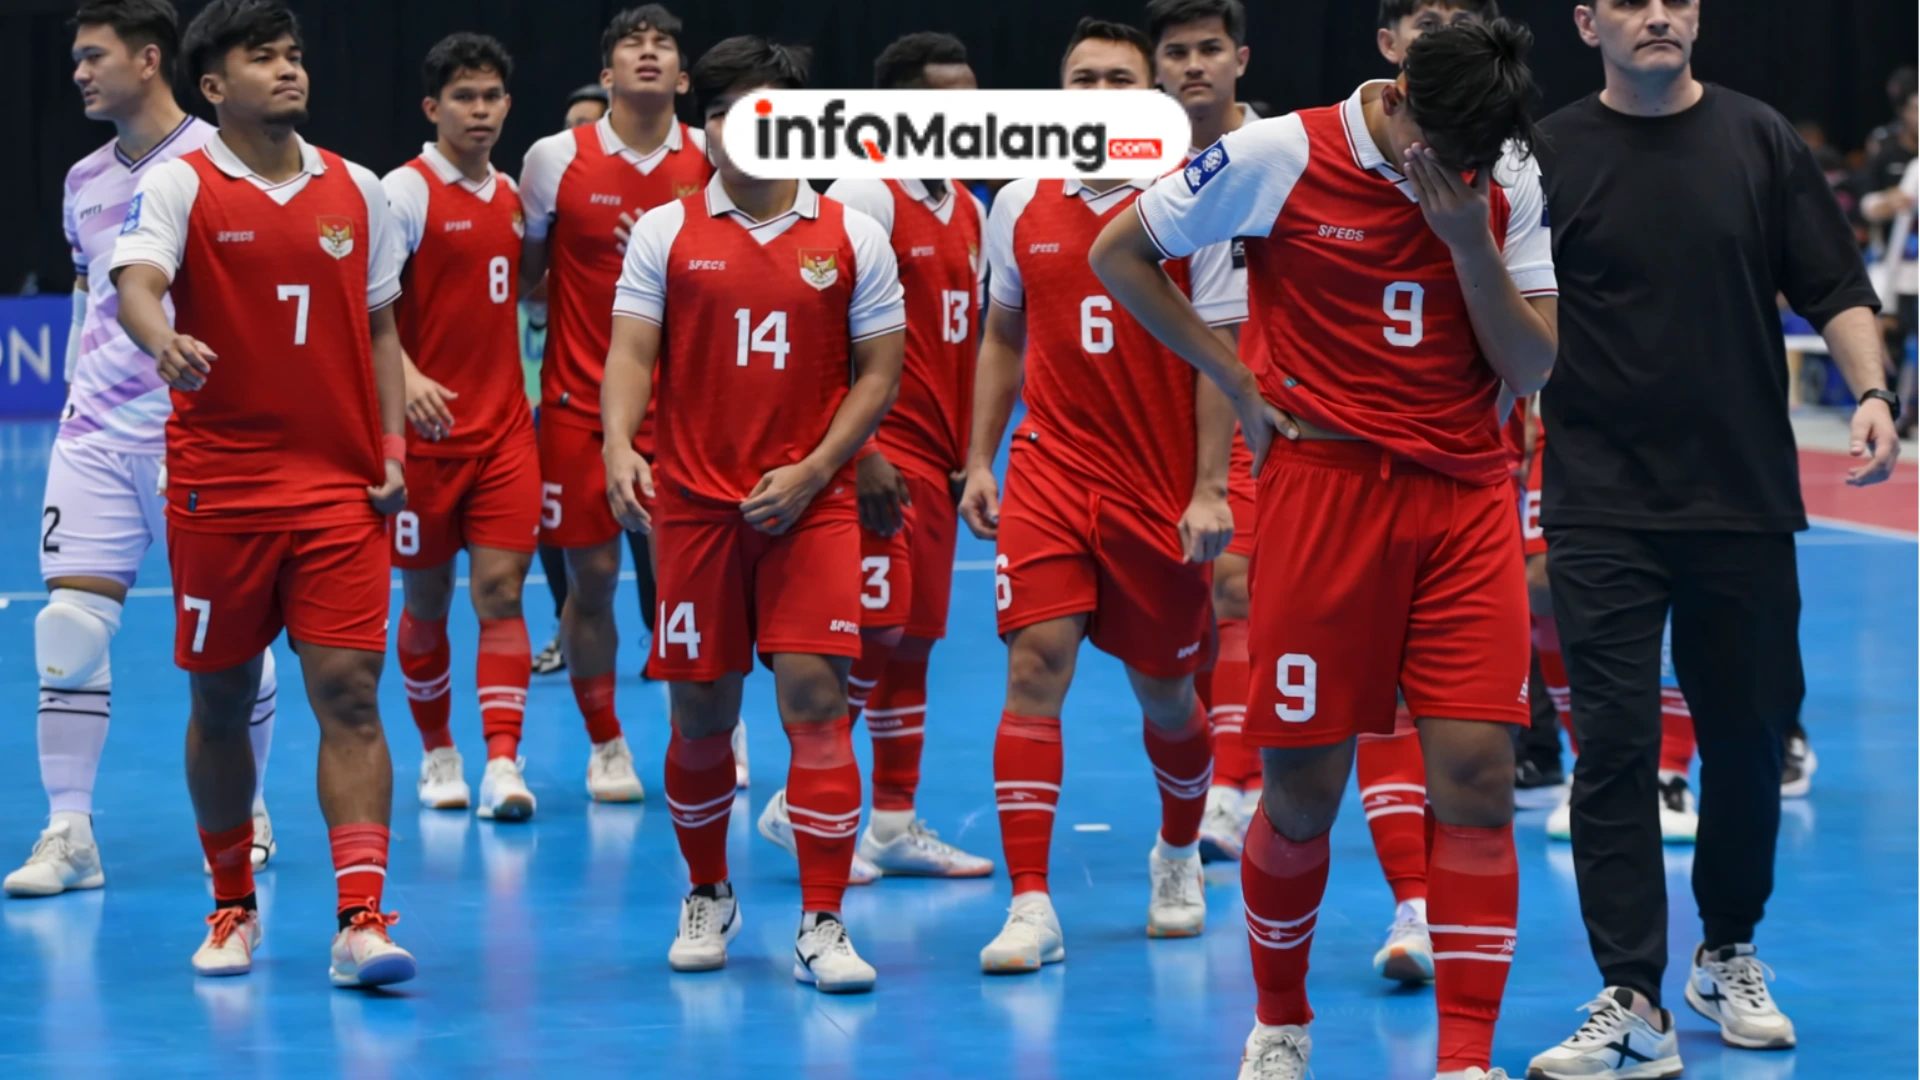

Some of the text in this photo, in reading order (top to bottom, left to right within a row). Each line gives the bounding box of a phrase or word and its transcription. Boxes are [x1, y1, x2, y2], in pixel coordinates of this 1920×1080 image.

[489, 256, 509, 303] 8
[276, 284, 310, 345] 7
[735, 308, 791, 370] 14
[942, 289, 970, 344] 13
[1080, 295, 1114, 354] 6
[1383, 281, 1424, 348] 9
[43, 506, 61, 553] 2
[395, 510, 420, 556] 8
[542, 482, 562, 529] 5
[996, 553, 1012, 611] 6
[183, 594, 211, 652] 7
[659, 600, 701, 659] 14
[1275, 653, 1317, 722] 9
